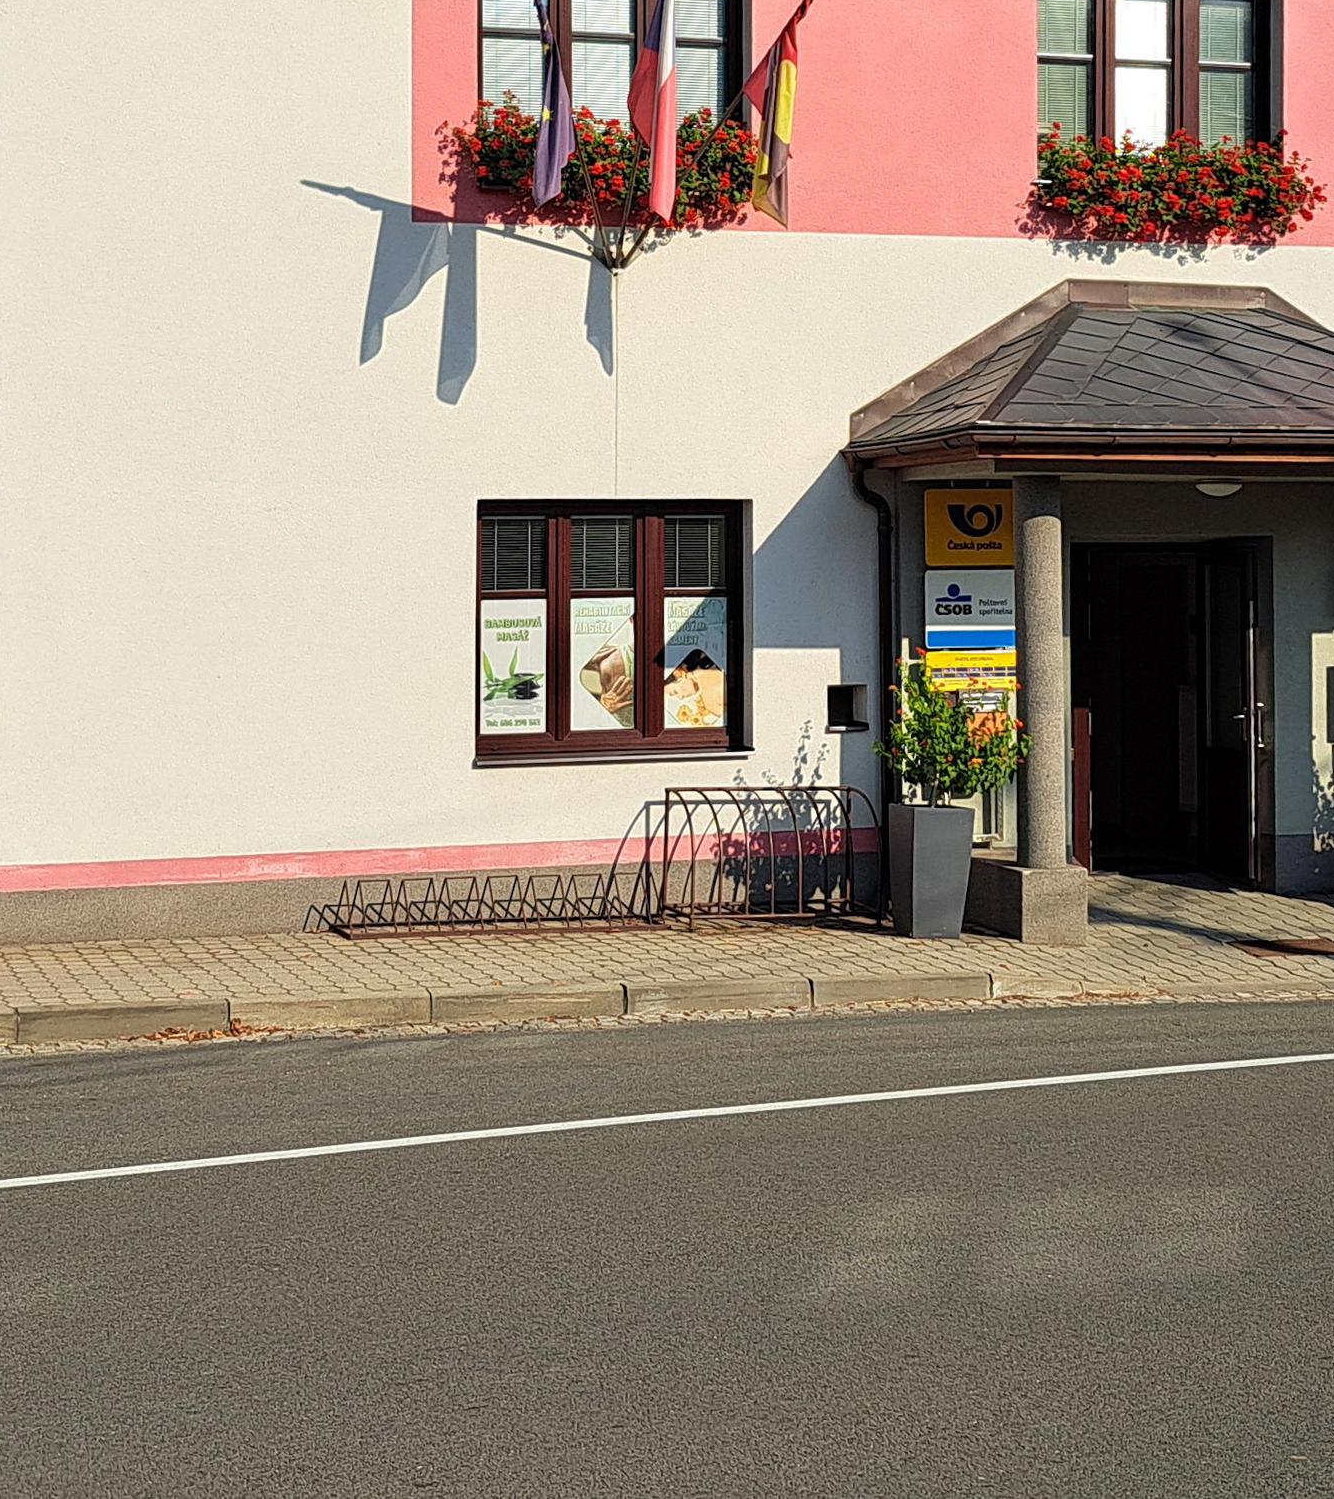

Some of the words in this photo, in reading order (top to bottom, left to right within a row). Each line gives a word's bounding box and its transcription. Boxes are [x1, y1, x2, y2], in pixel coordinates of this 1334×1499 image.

[947, 540, 975, 550] Česká
[977, 541, 1003, 551] pošta
[935, 603, 972, 615] ČSOB
[979, 608, 1013, 616] spořitelna
